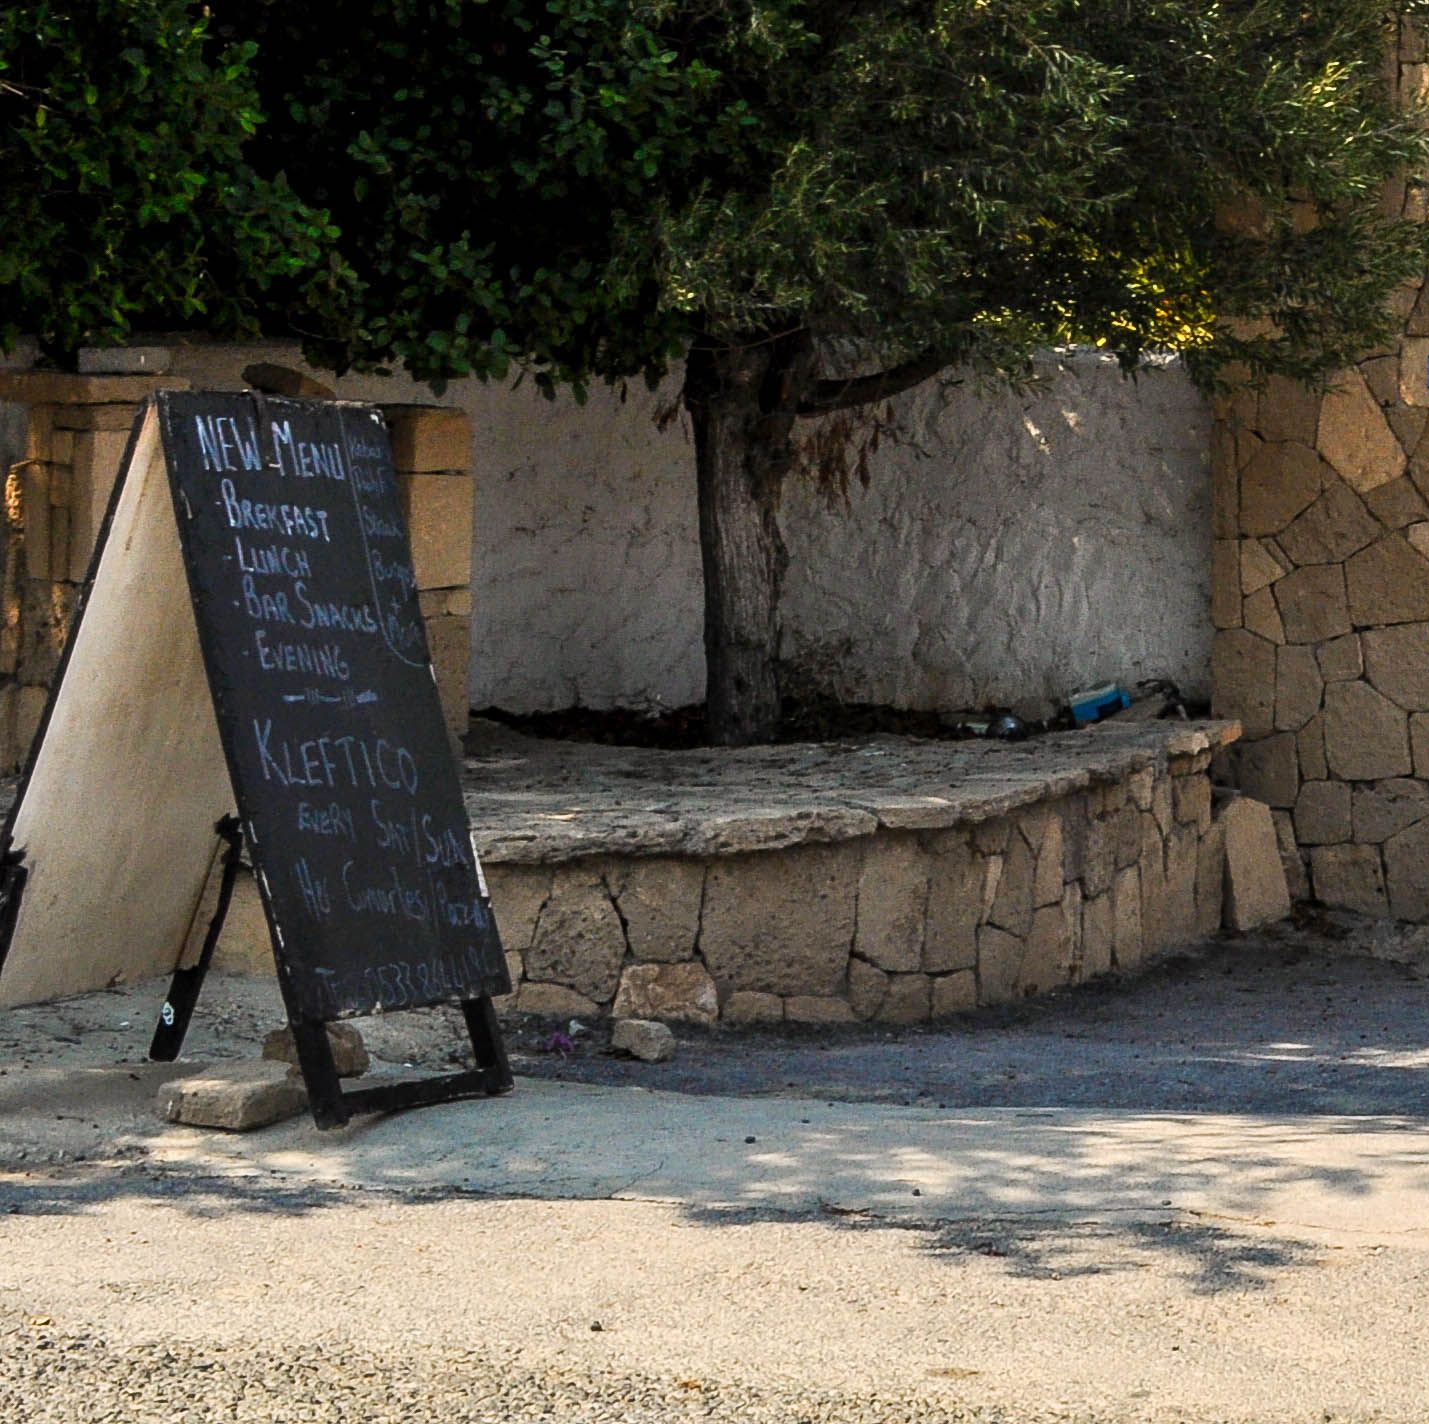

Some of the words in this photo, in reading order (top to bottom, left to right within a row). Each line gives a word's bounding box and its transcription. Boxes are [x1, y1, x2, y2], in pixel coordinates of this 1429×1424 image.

[195, 415, 262, 472] NEW
[271, 420, 345, 480] MENU
[235, 536, 312, 578] LUNCH
[242, 574, 296, 624] BAR
[294, 580, 378, 633] SNACKS
[255, 630, 350, 681] EVENING
[253, 719, 418, 795] KLEFTICO
